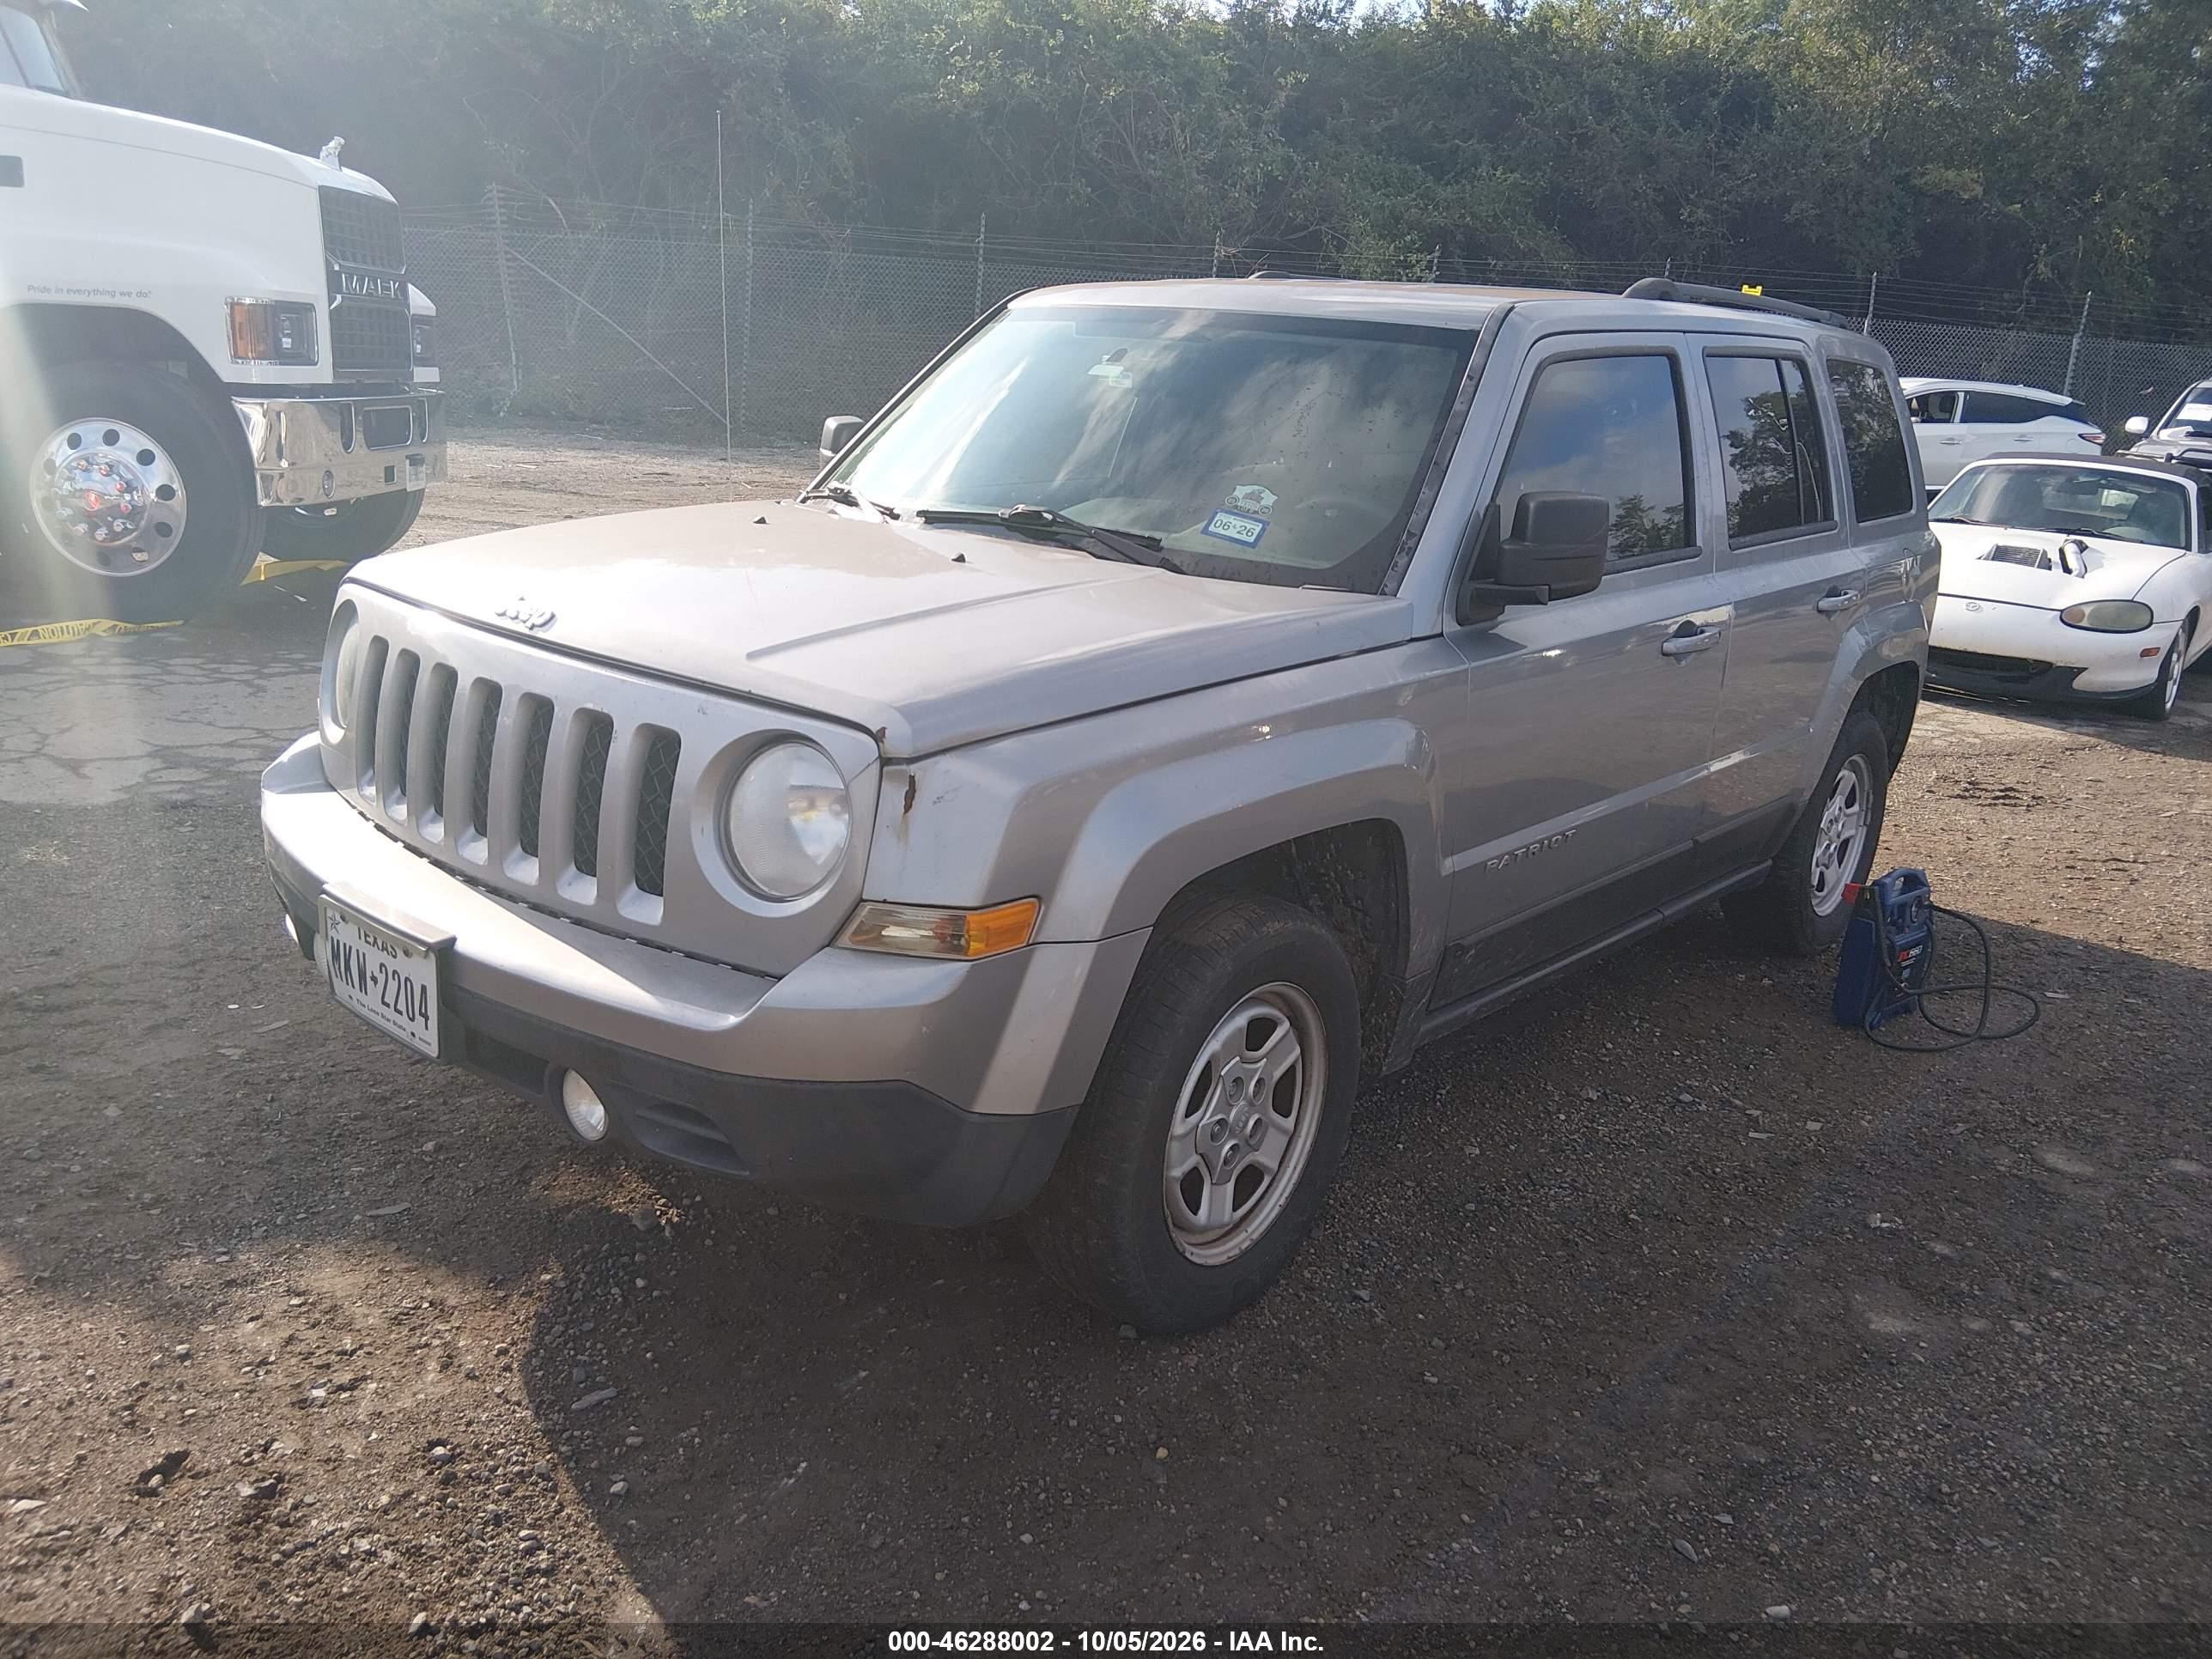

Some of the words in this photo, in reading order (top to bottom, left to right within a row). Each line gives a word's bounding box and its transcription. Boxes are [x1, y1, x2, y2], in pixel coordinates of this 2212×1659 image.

[27, 284, 52, 295] Pride
[55, 285, 64, 295] in
[66, 287, 116, 298] everything
[342, 272, 404, 299] MACK
[1213, 519, 1232, 531] 06
[1237, 524, 1256, 538] 26
[1485, 829, 1577, 874] PATRIOT
[357, 927, 398, 958] TEXAS
[356, 998, 366, 1008] The
[367, 1005, 380, 1016] Lone
[380, 1012, 392, 1024] Star
[392, 1019, 406, 1032] State
